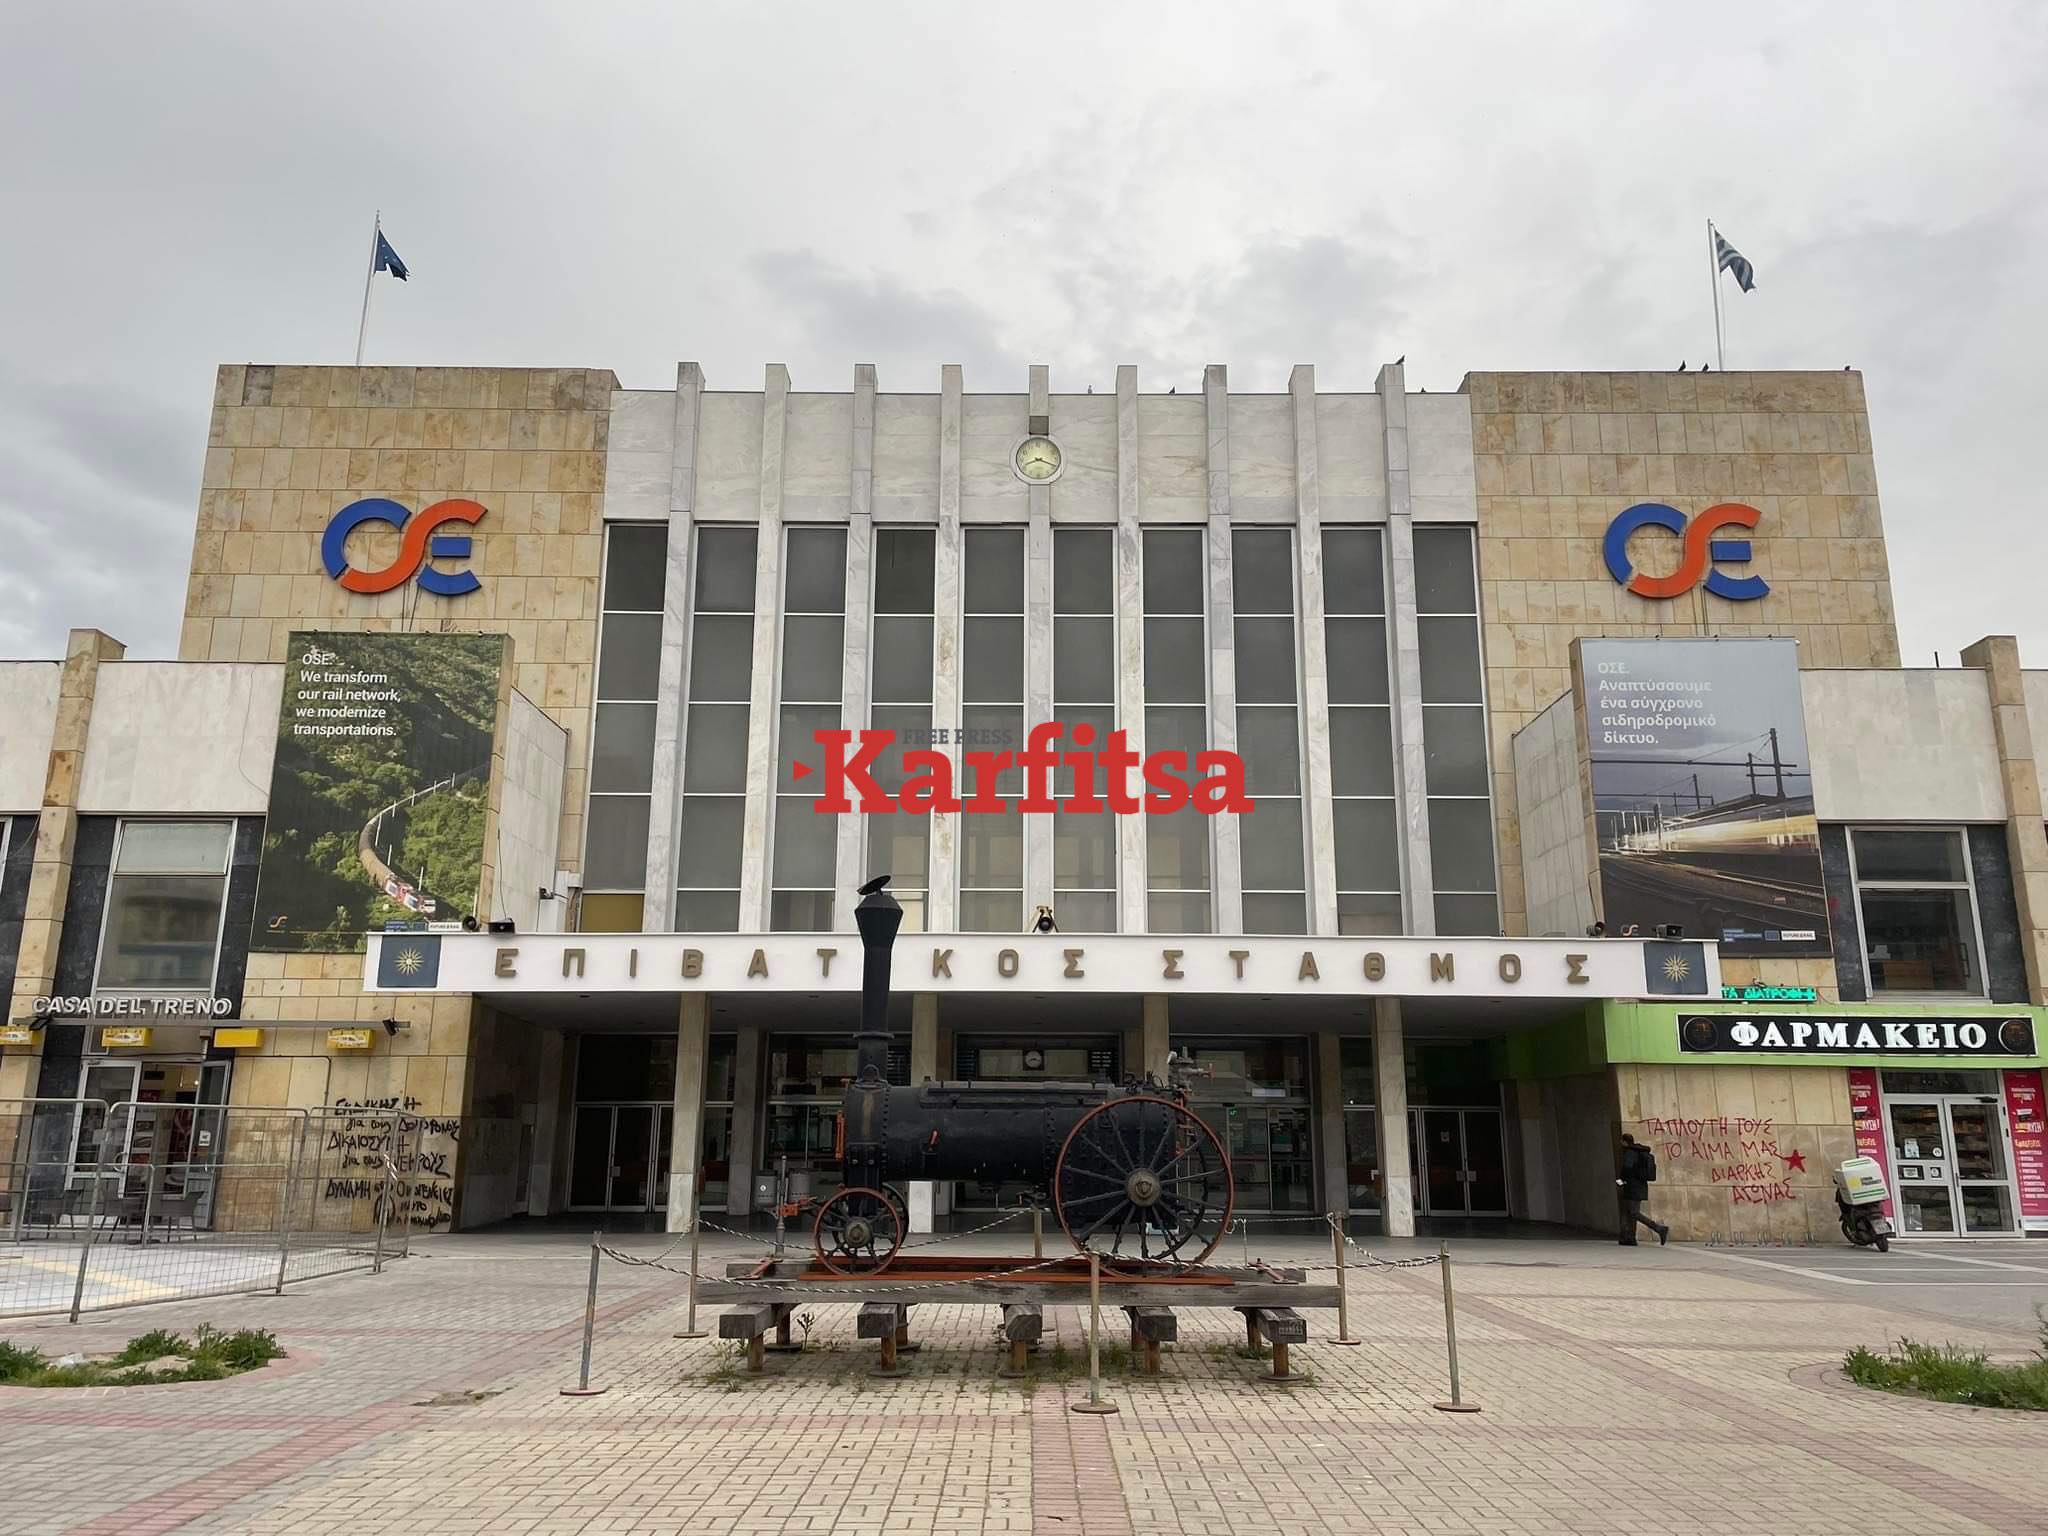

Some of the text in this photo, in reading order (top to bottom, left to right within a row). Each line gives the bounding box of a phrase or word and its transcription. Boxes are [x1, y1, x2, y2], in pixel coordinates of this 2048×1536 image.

[300, 670, 388, 683] We transform
[1599, 679, 1713, 694] Αναπτύσσουμε
[297, 688, 401, 703] our rail network,
[1600, 696, 1703, 712] ένα σύγχρονο
[296, 706, 387, 718] we modernize
[1602, 714, 1717, 729] σιδηροδρομικό
[294, 723, 397, 738] transportations.
[1603, 731, 1660, 744] δίκτυο.
[494, 947, 1590, 984] ΕΠΙΒΑΤΚΟΣ ΣΤΑΘΜΟΣ
[32, 996, 233, 1015] CASA DEL TRENO
[1729, 1021, 1987, 1050] ΦΑΡΜΑΚΕΙΟ
[1733, 1118, 1773, 1136] ΤΟΥΣ
[1656, 1140, 1784, 1161] ΤΟ ΑΙΜΑ ΜΑΣ
[1711, 1162, 1777, 1183] ΔΙΑΡΚΗΣ
